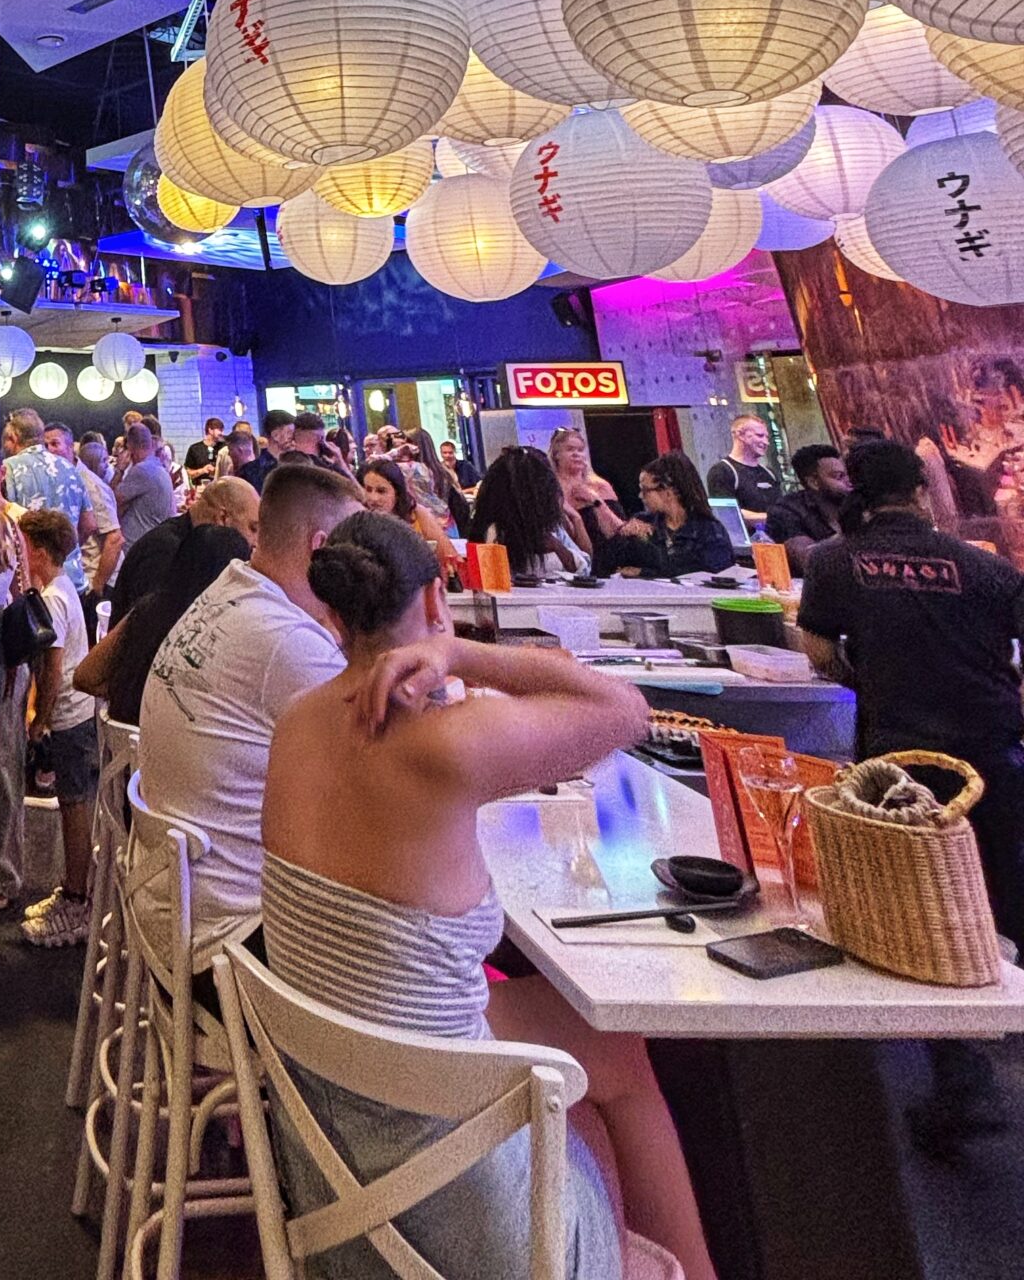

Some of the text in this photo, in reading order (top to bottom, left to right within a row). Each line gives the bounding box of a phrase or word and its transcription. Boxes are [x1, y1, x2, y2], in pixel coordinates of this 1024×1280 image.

[533, 141, 563, 224] ウナギ
[936, 171, 992, 262] ウナギ
[516, 371, 617, 394] FOTOS
